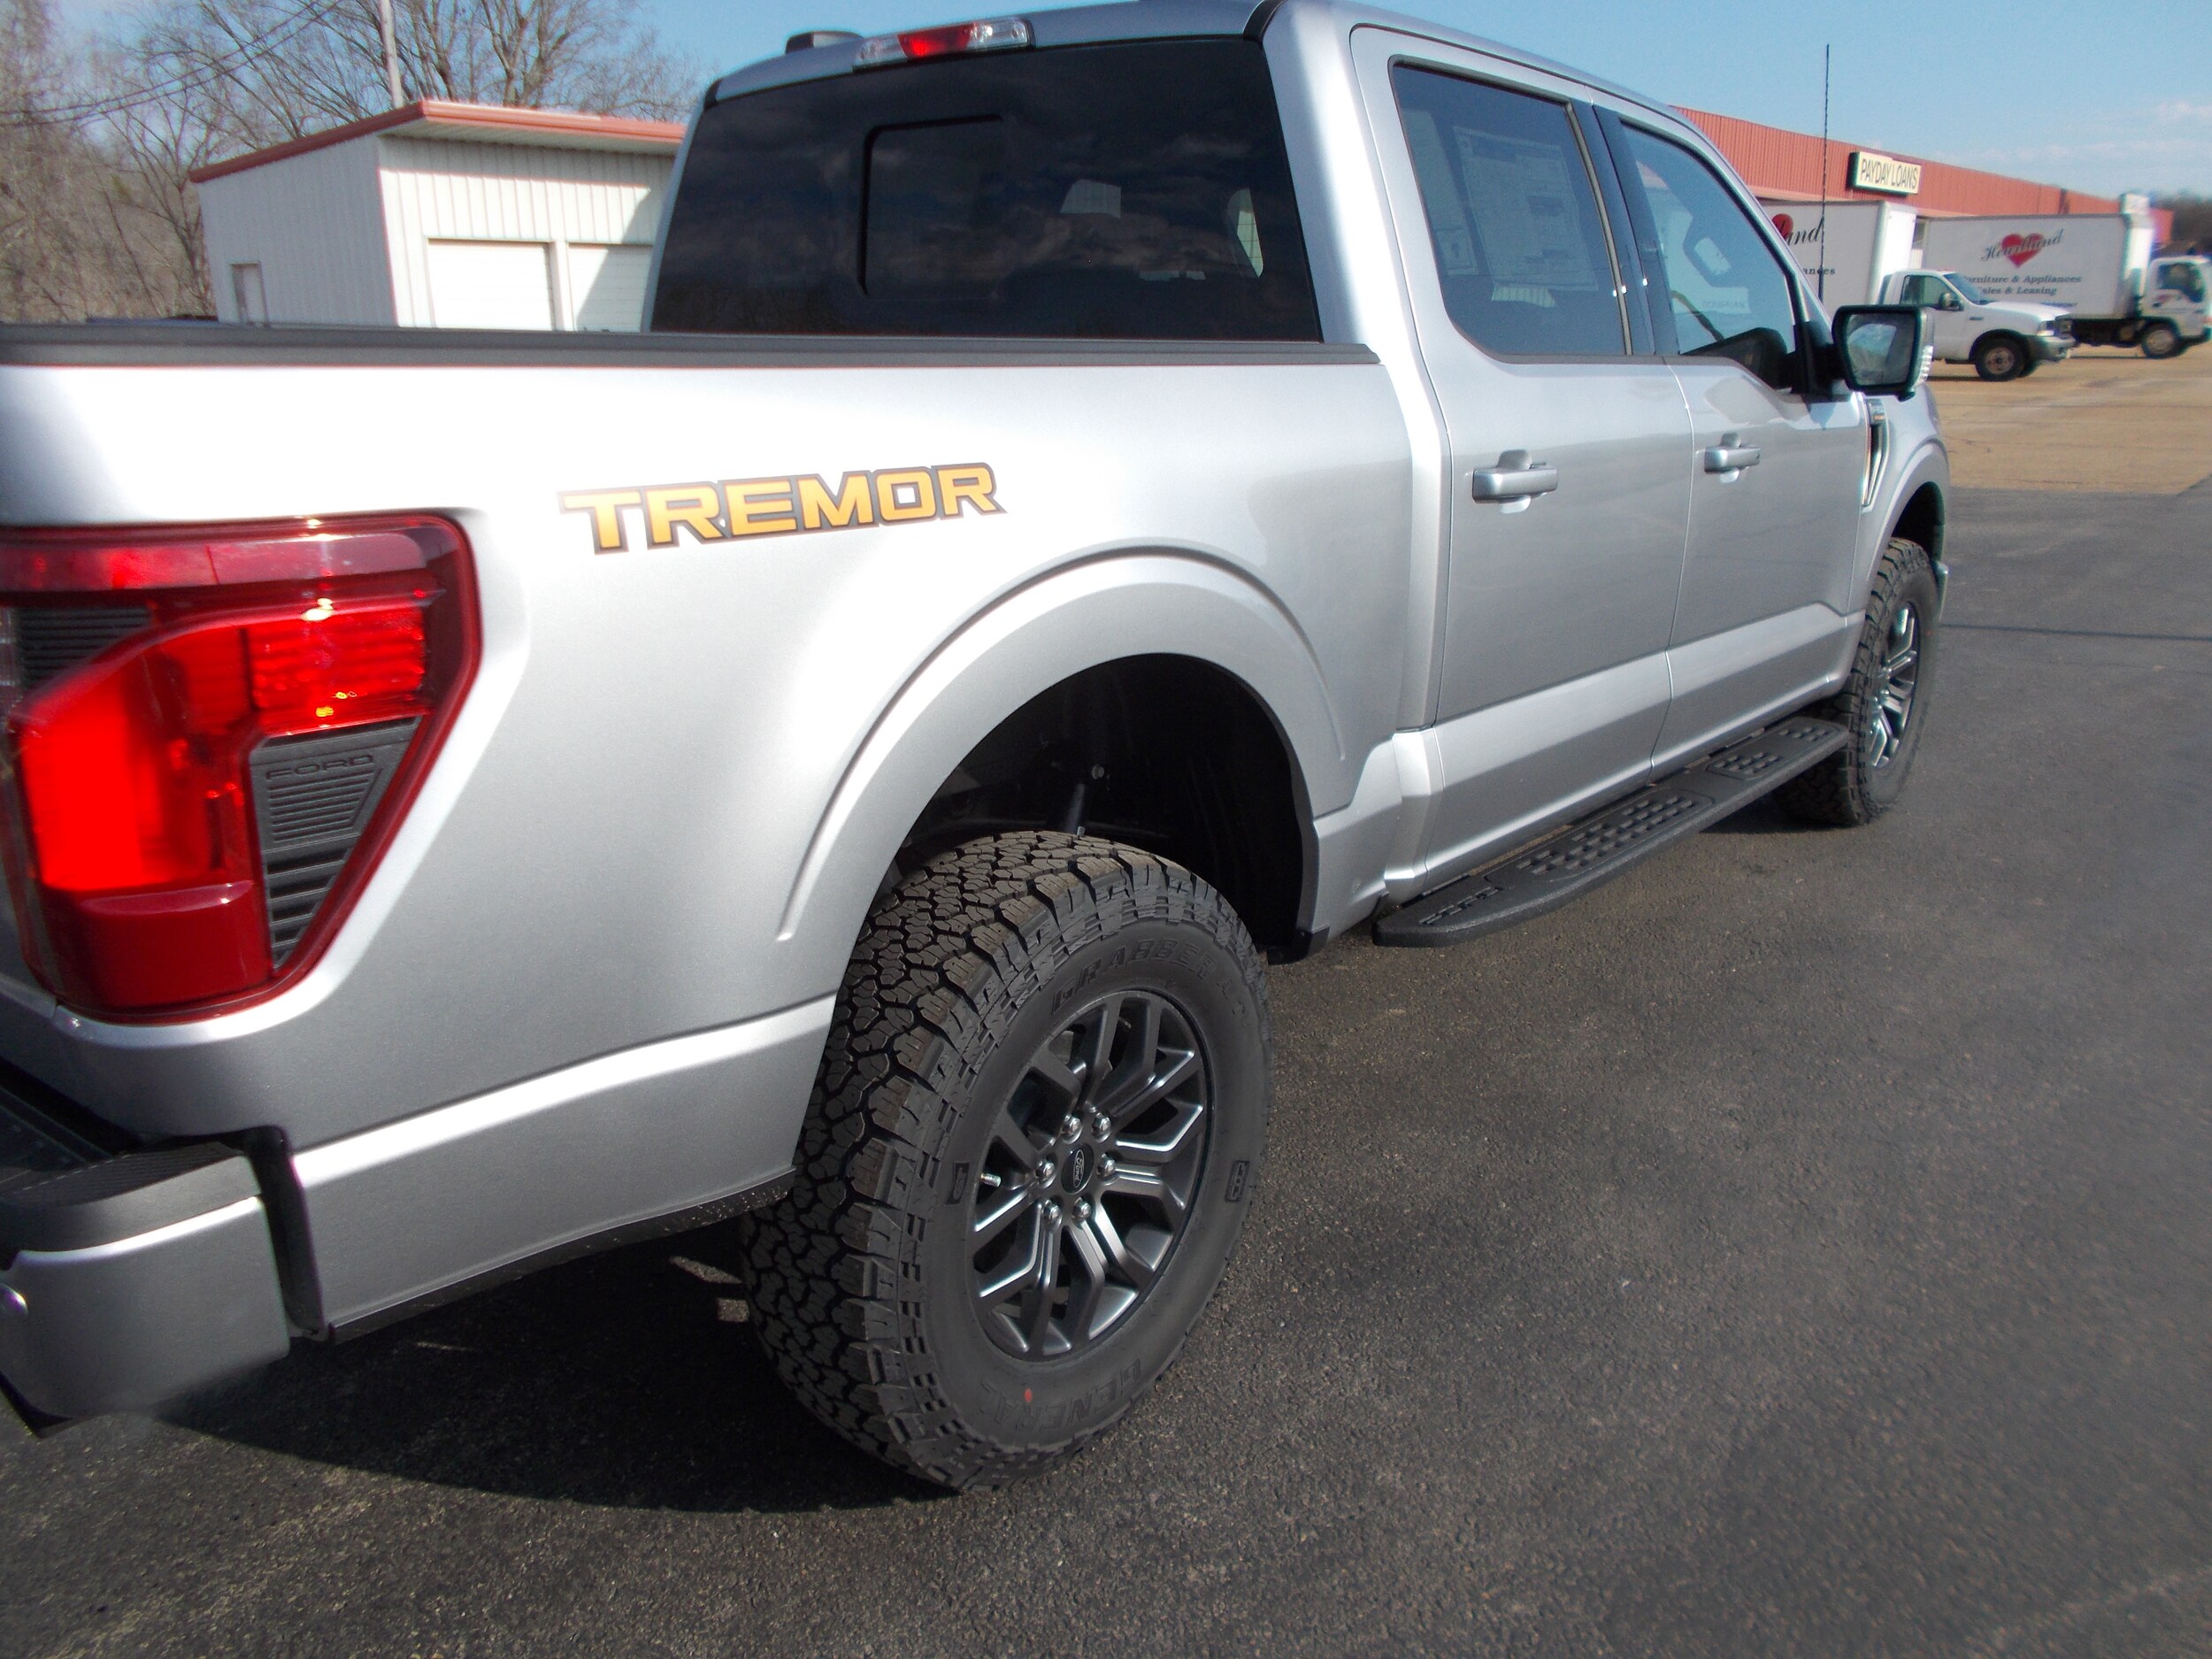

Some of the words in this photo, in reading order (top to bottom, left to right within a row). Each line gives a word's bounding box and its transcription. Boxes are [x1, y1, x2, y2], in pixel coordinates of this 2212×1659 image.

[1861, 158, 1892, 185] PAYDAY
[1891, 163, 1919, 189] LOANS
[1981, 227, 2064, 261] Heartland
[1963, 274, 2008, 283] urniture
[2011, 274, 2020, 283] &
[2024, 273, 2082, 285] Appliances
[1978, 286, 2001, 295] ales
[2005, 286, 2014, 295] &
[2017, 285, 2057, 296] Leasing
[556, 462, 1007, 556] TREMOR
[266, 754, 373, 780] FORD
